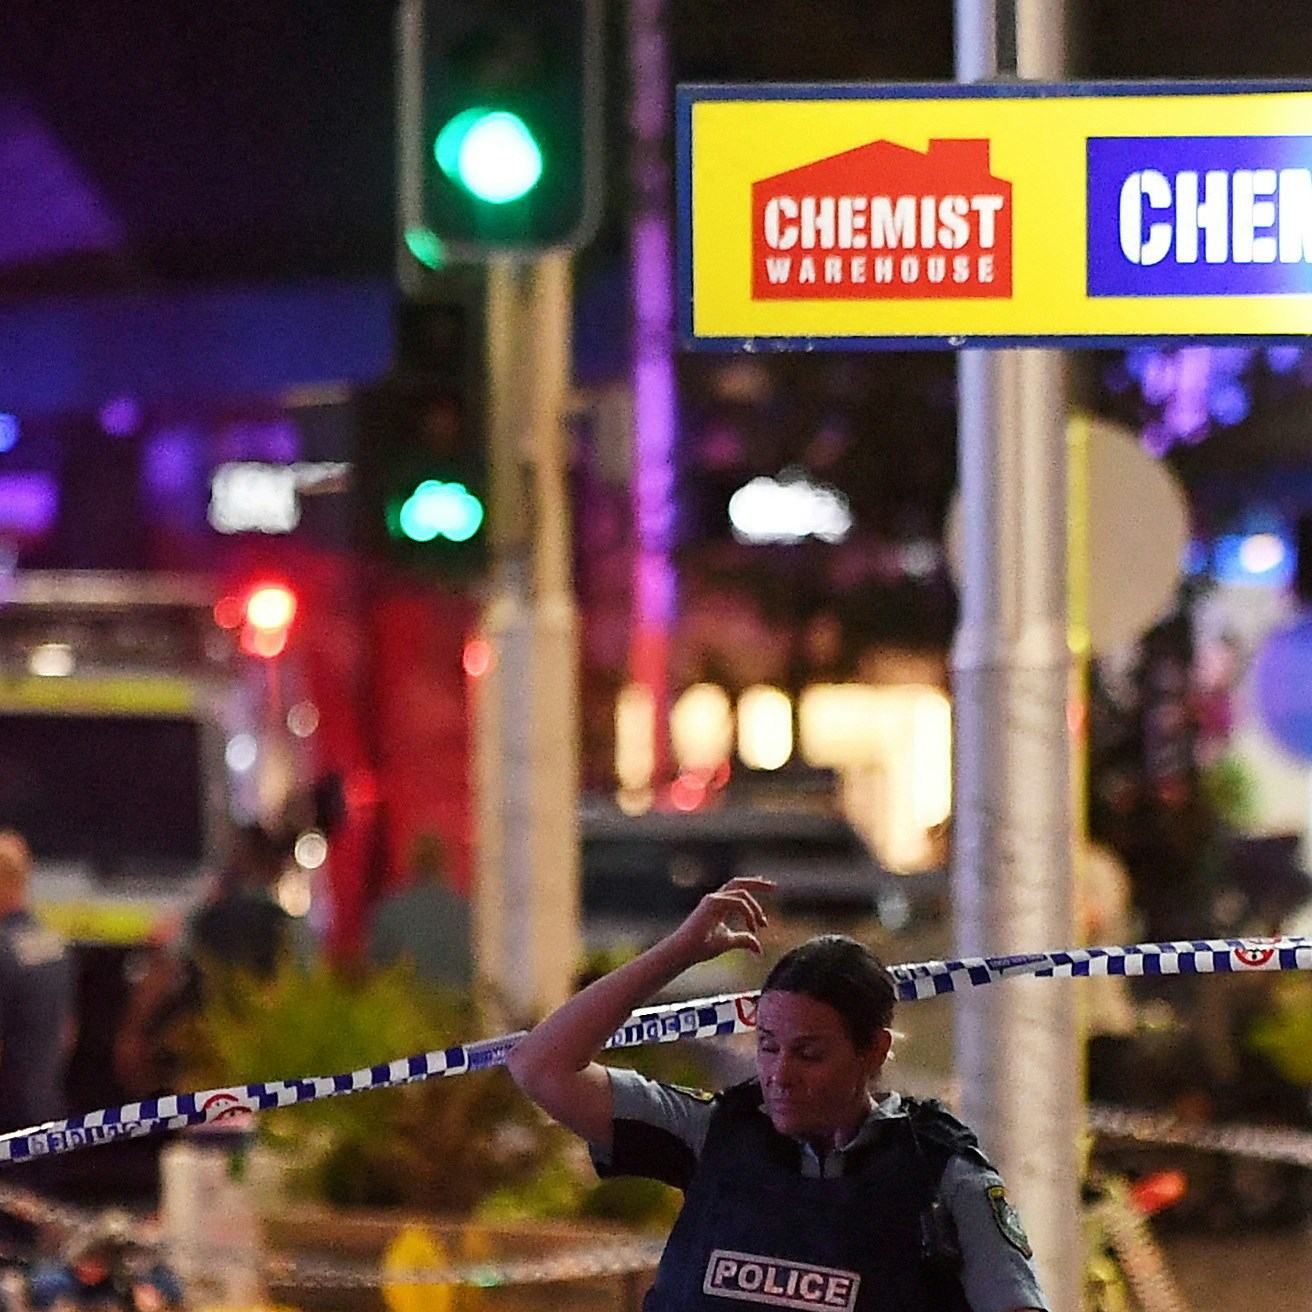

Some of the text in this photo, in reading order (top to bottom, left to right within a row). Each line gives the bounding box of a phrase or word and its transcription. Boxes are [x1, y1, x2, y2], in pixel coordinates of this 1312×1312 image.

[763, 193, 1005, 250] CHEMIST
[765, 254, 995, 284] WAREHOUSE
[713, 1259, 850, 1305] POLICE
